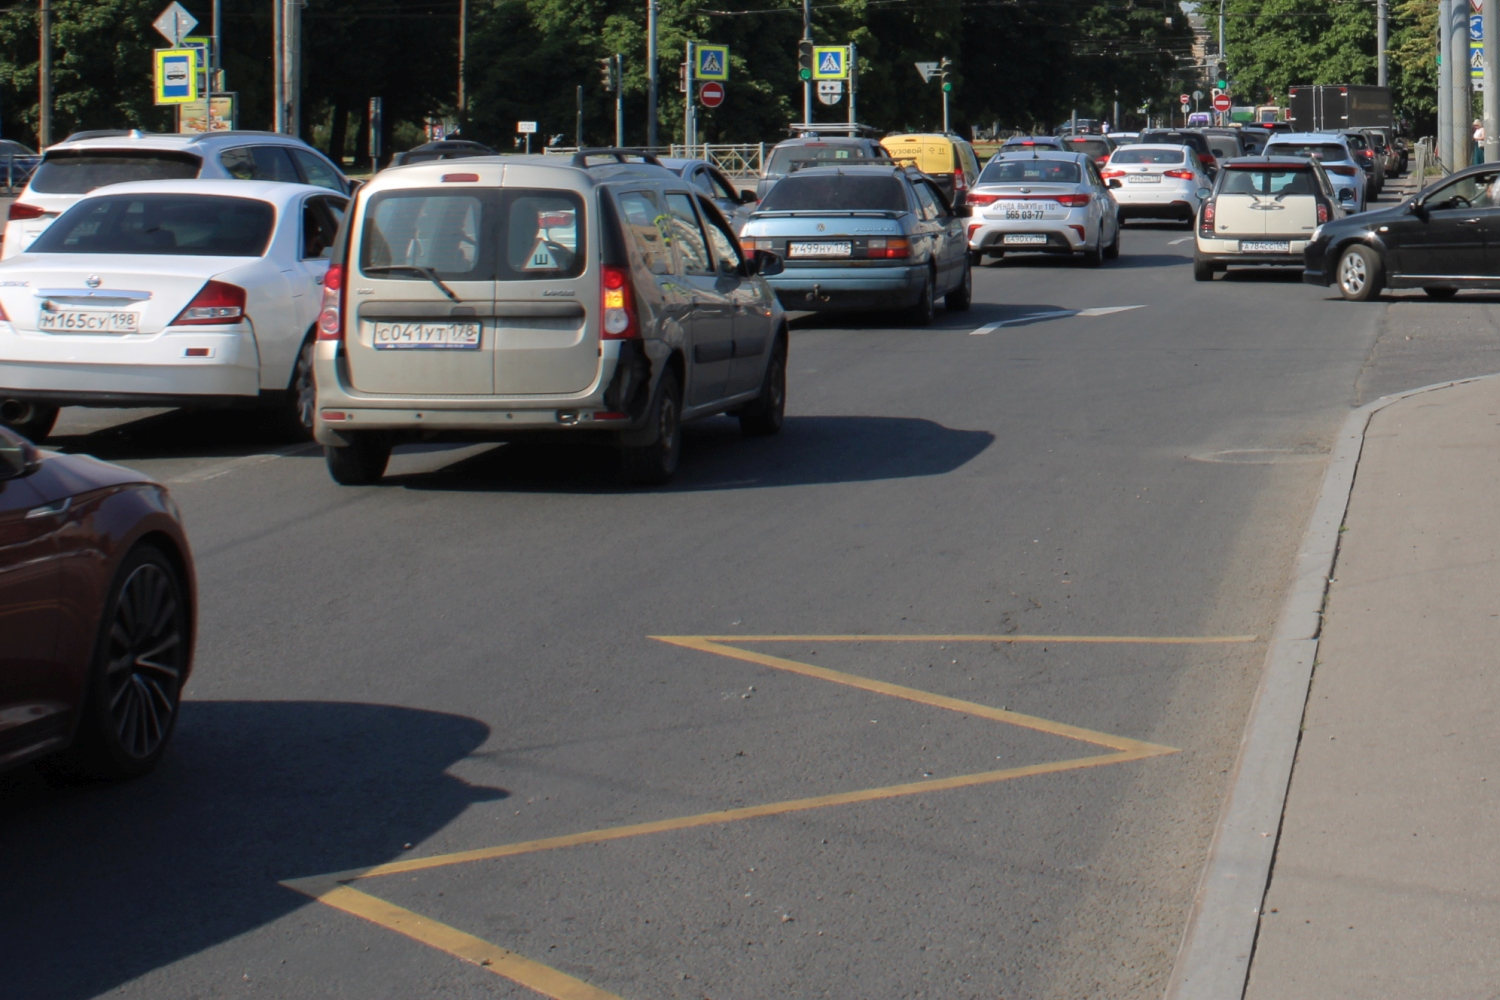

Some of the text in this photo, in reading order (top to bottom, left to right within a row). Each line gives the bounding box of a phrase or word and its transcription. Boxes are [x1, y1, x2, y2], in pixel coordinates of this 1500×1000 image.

[1006, 210, 1044, 220] 565 03-77
[535, 254, 548, 265] Ш
[43, 313, 135, 328] М165СУ 198
[380, 325, 446, 341] С041УТ
